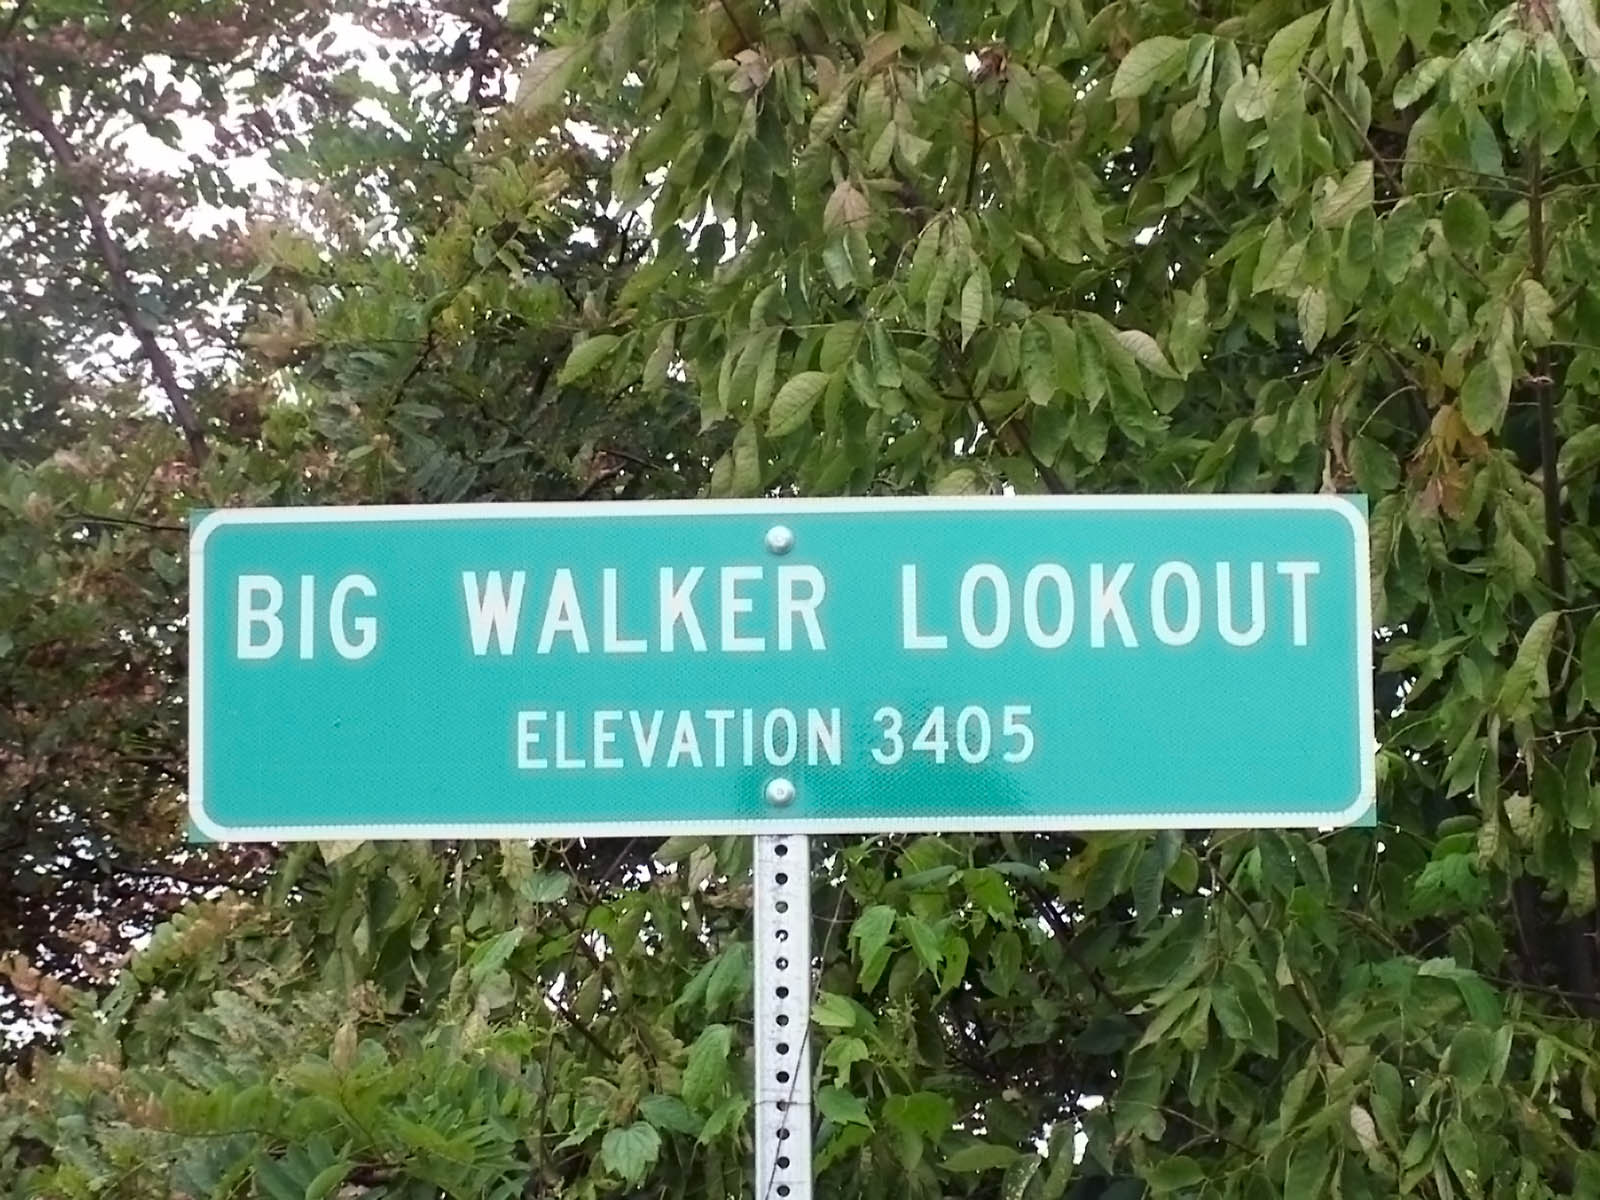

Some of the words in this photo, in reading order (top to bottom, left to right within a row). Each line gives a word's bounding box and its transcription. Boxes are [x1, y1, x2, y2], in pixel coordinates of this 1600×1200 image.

[236, 574, 378, 660] BIG
[462, 564, 826, 655] WALKER
[902, 560, 1320, 649] LOOKOUT
[516, 707, 842, 769] ELEVATION
[871, 704, 1035, 765] 3405
